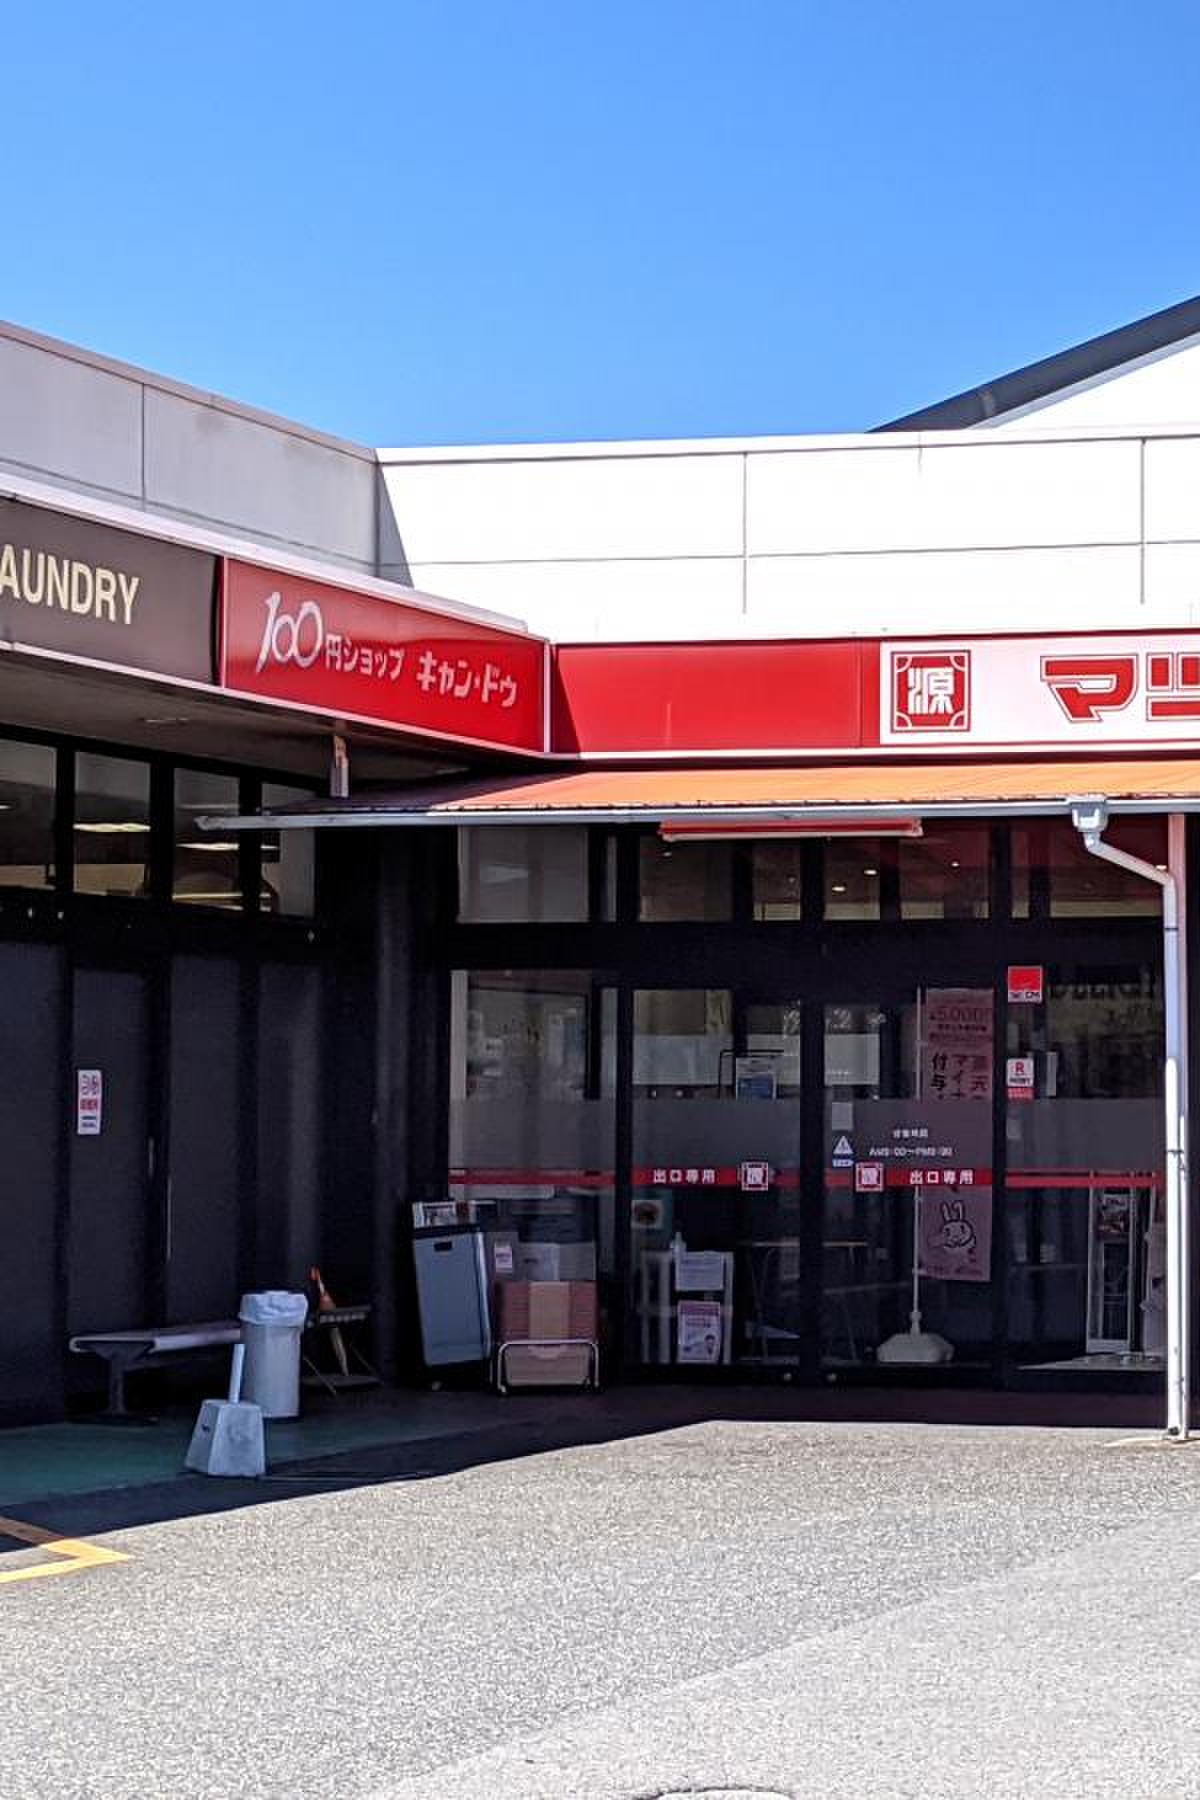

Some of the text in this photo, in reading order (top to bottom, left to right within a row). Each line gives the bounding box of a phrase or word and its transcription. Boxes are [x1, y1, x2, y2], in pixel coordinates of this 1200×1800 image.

[0, 543, 140, 625] AUNDRY
[907, 665, 954, 714] 源
[909, 1169, 974, 1185] 出口専用
